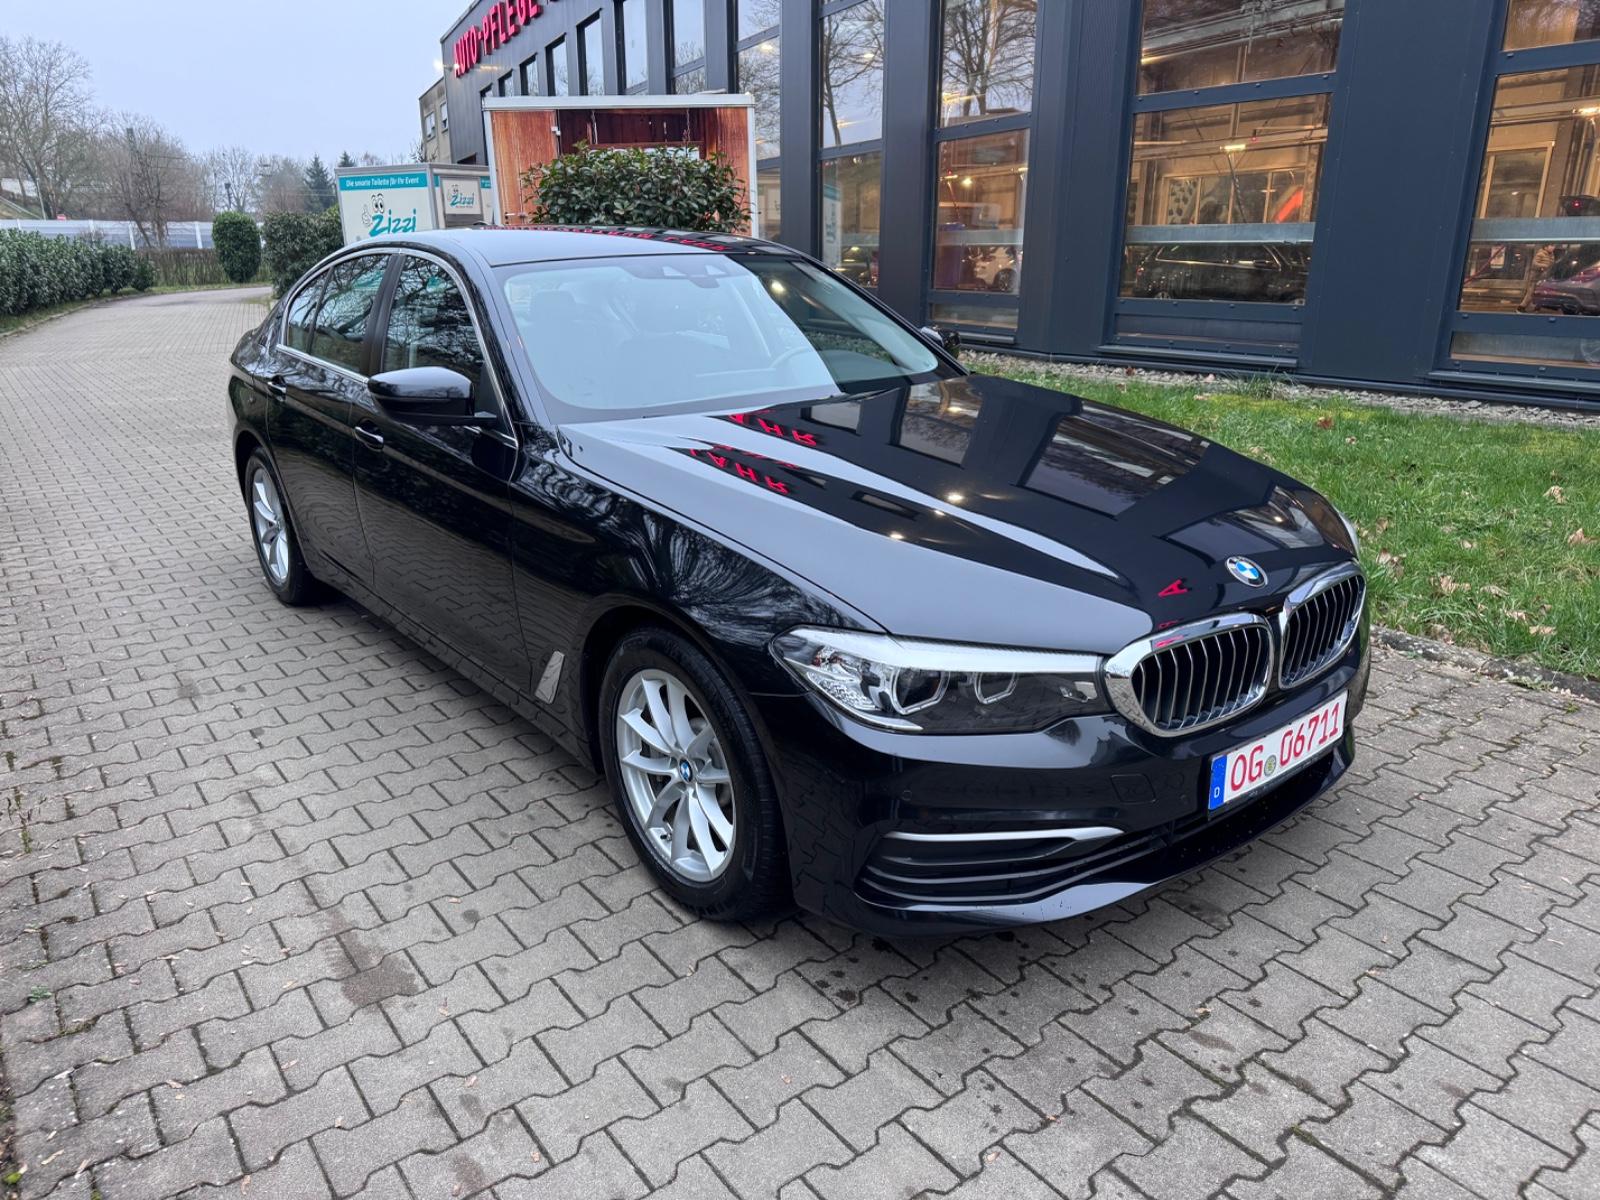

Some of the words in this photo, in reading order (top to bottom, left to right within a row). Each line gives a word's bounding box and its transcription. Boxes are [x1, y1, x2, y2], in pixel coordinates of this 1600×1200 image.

[1230, 744, 1265, 791] OG
[1278, 702, 1341, 767] 06711
[1213, 786, 1221, 798] D
